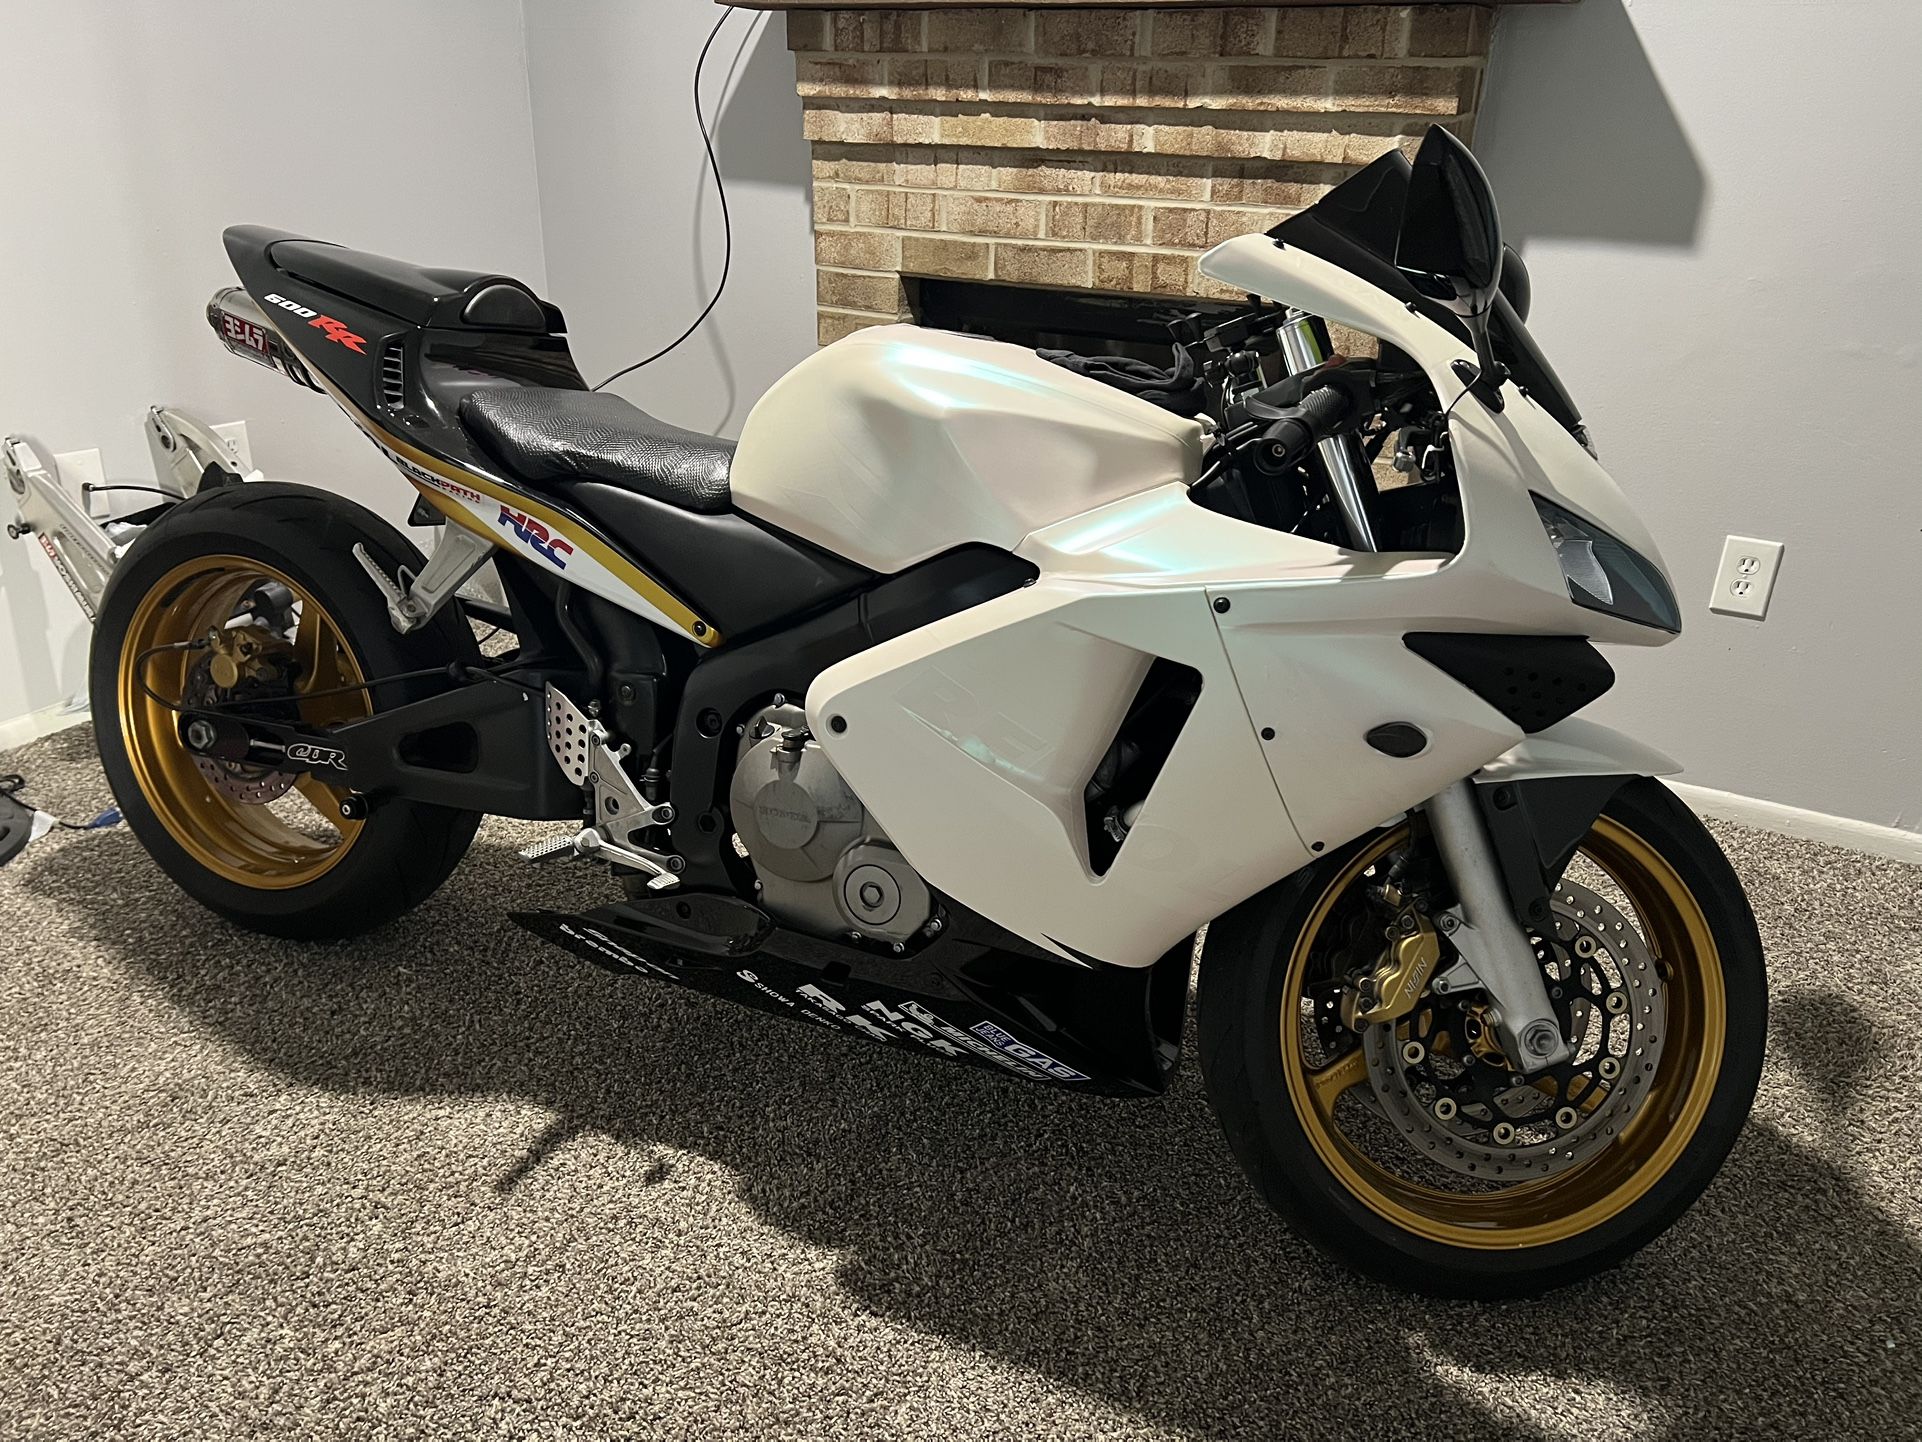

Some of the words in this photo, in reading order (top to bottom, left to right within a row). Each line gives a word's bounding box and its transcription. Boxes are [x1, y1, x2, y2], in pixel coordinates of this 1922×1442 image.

[498, 505, 573, 570] HRC
[286, 742, 349, 771] CBR
[560, 923, 648, 974] brembo
[754, 982, 795, 1007] SHOWA
[801, 1009, 840, 1030] DENKO
[866, 1000, 970, 1056] NGK
[940, 1026, 1045, 1078] MICHELIN
[975, 1027, 1005, 1046] JEANS
[984, 1024, 1011, 1043] BLUE
[1004, 1043, 1076, 1078] GAS
